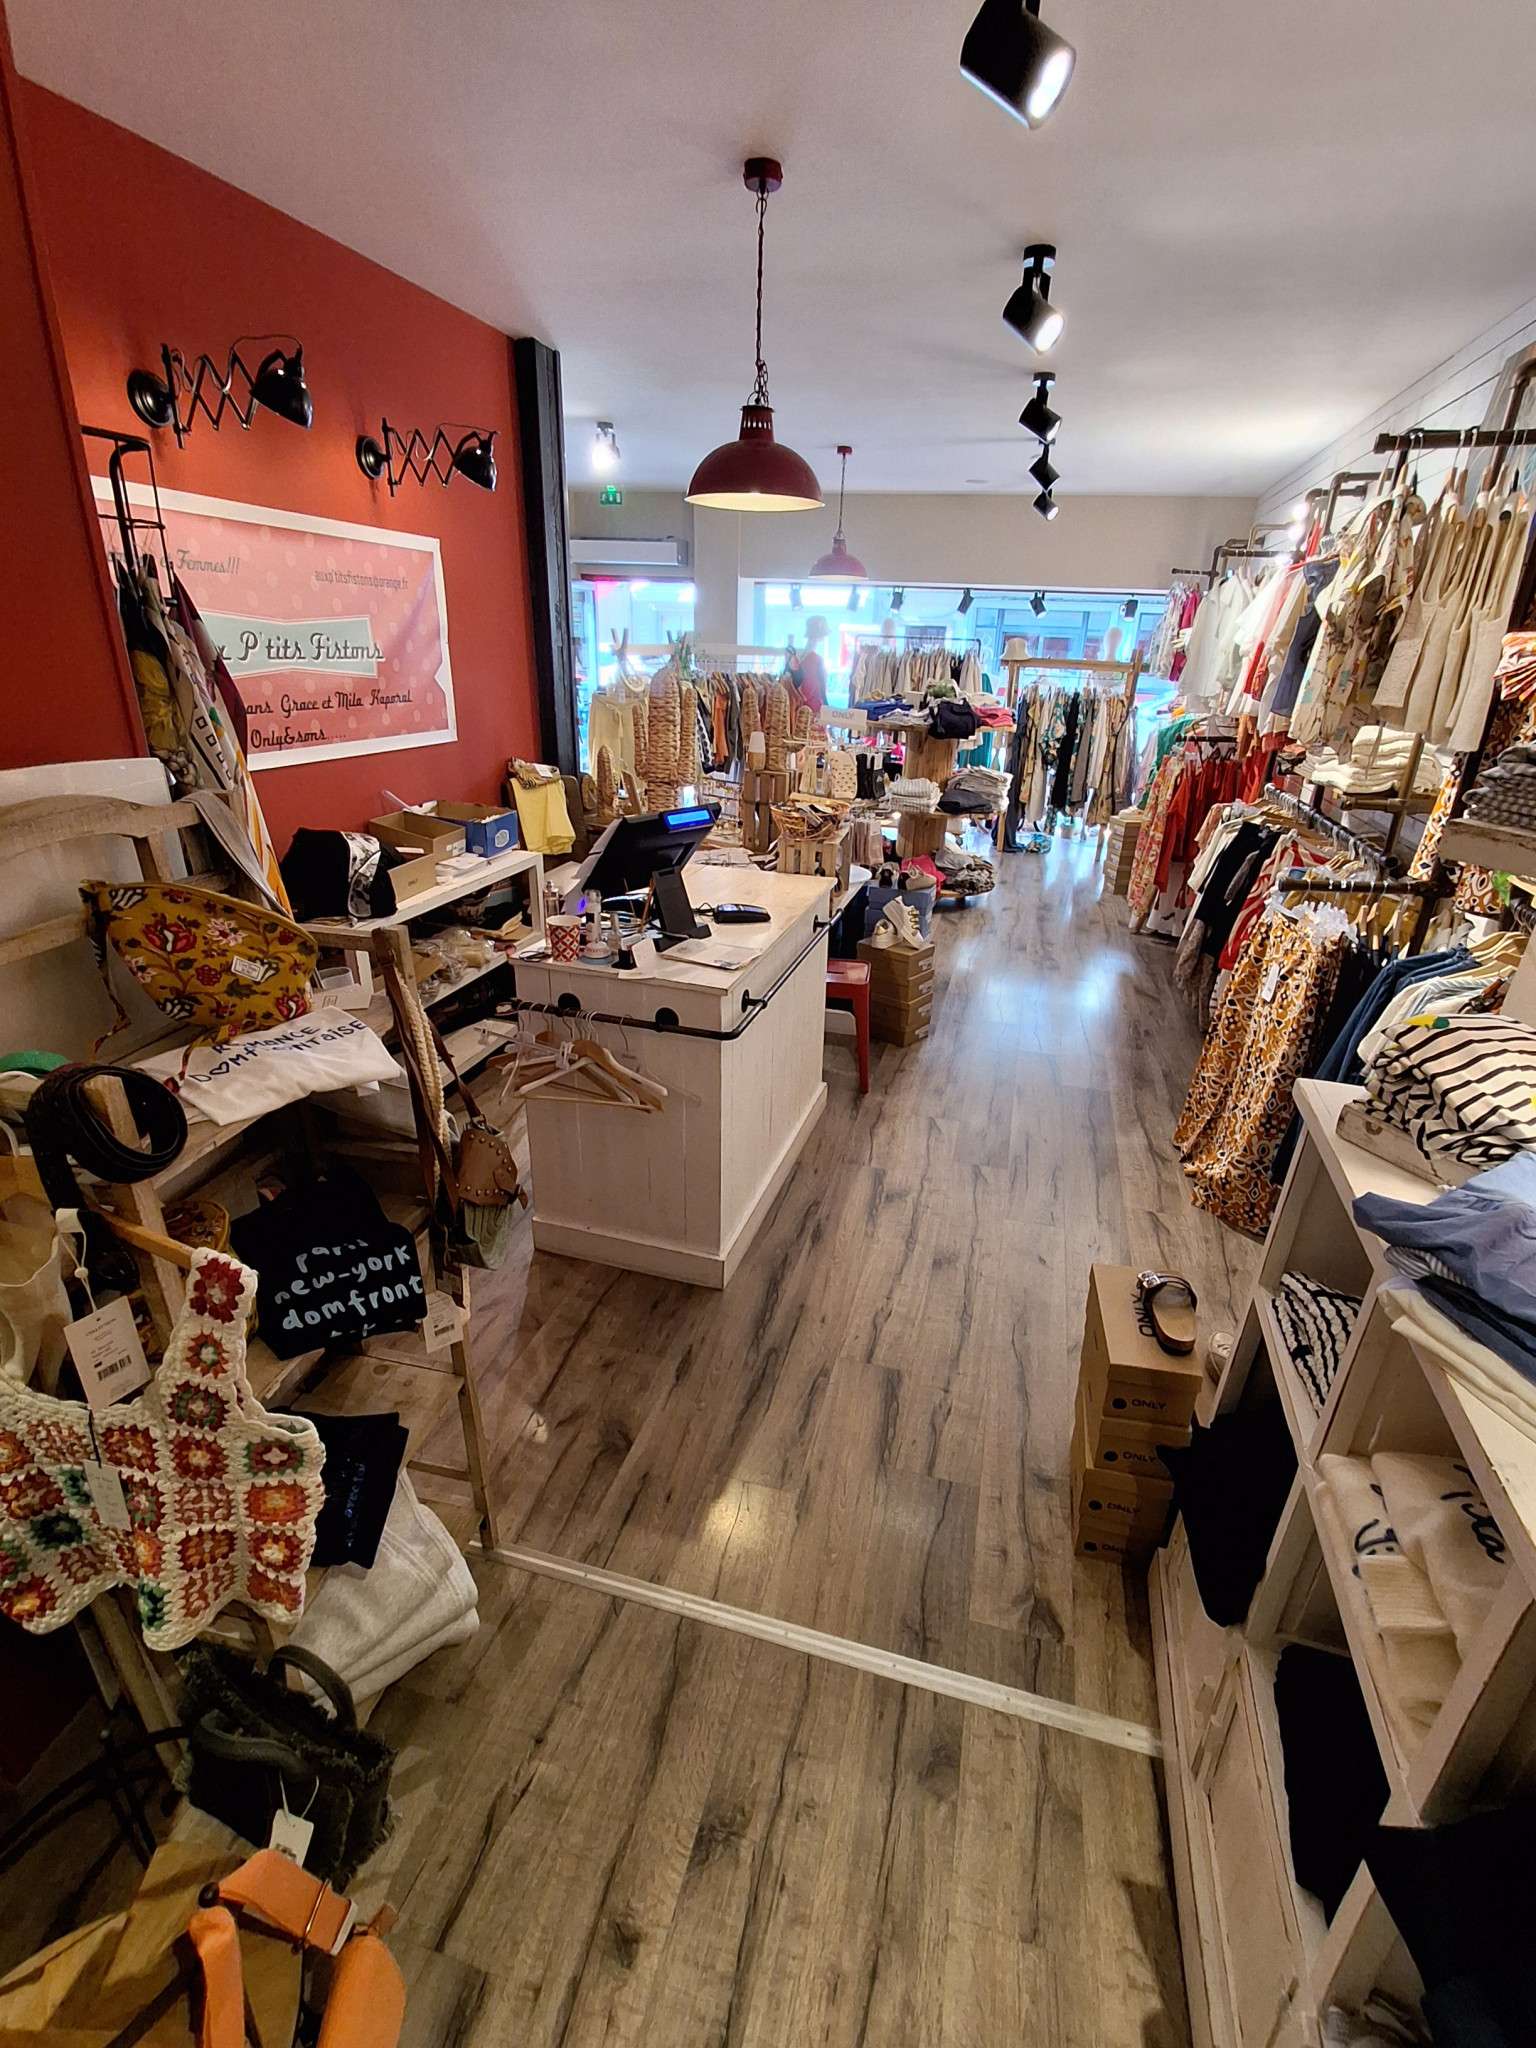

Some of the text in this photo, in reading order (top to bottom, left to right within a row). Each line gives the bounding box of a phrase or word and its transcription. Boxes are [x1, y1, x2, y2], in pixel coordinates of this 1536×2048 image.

[237, 630, 308, 662] P'tits
[310, 631, 385, 661] Fistons
[281, 694, 319, 718] Grace
[321, 698, 335, 710] et
[335, 691, 364, 711] Mila
[282, 1275, 423, 1330] domfront
[1131, 1398, 1167, 1411] ONLY
[1122, 1451, 1156, 1463] ONLY
